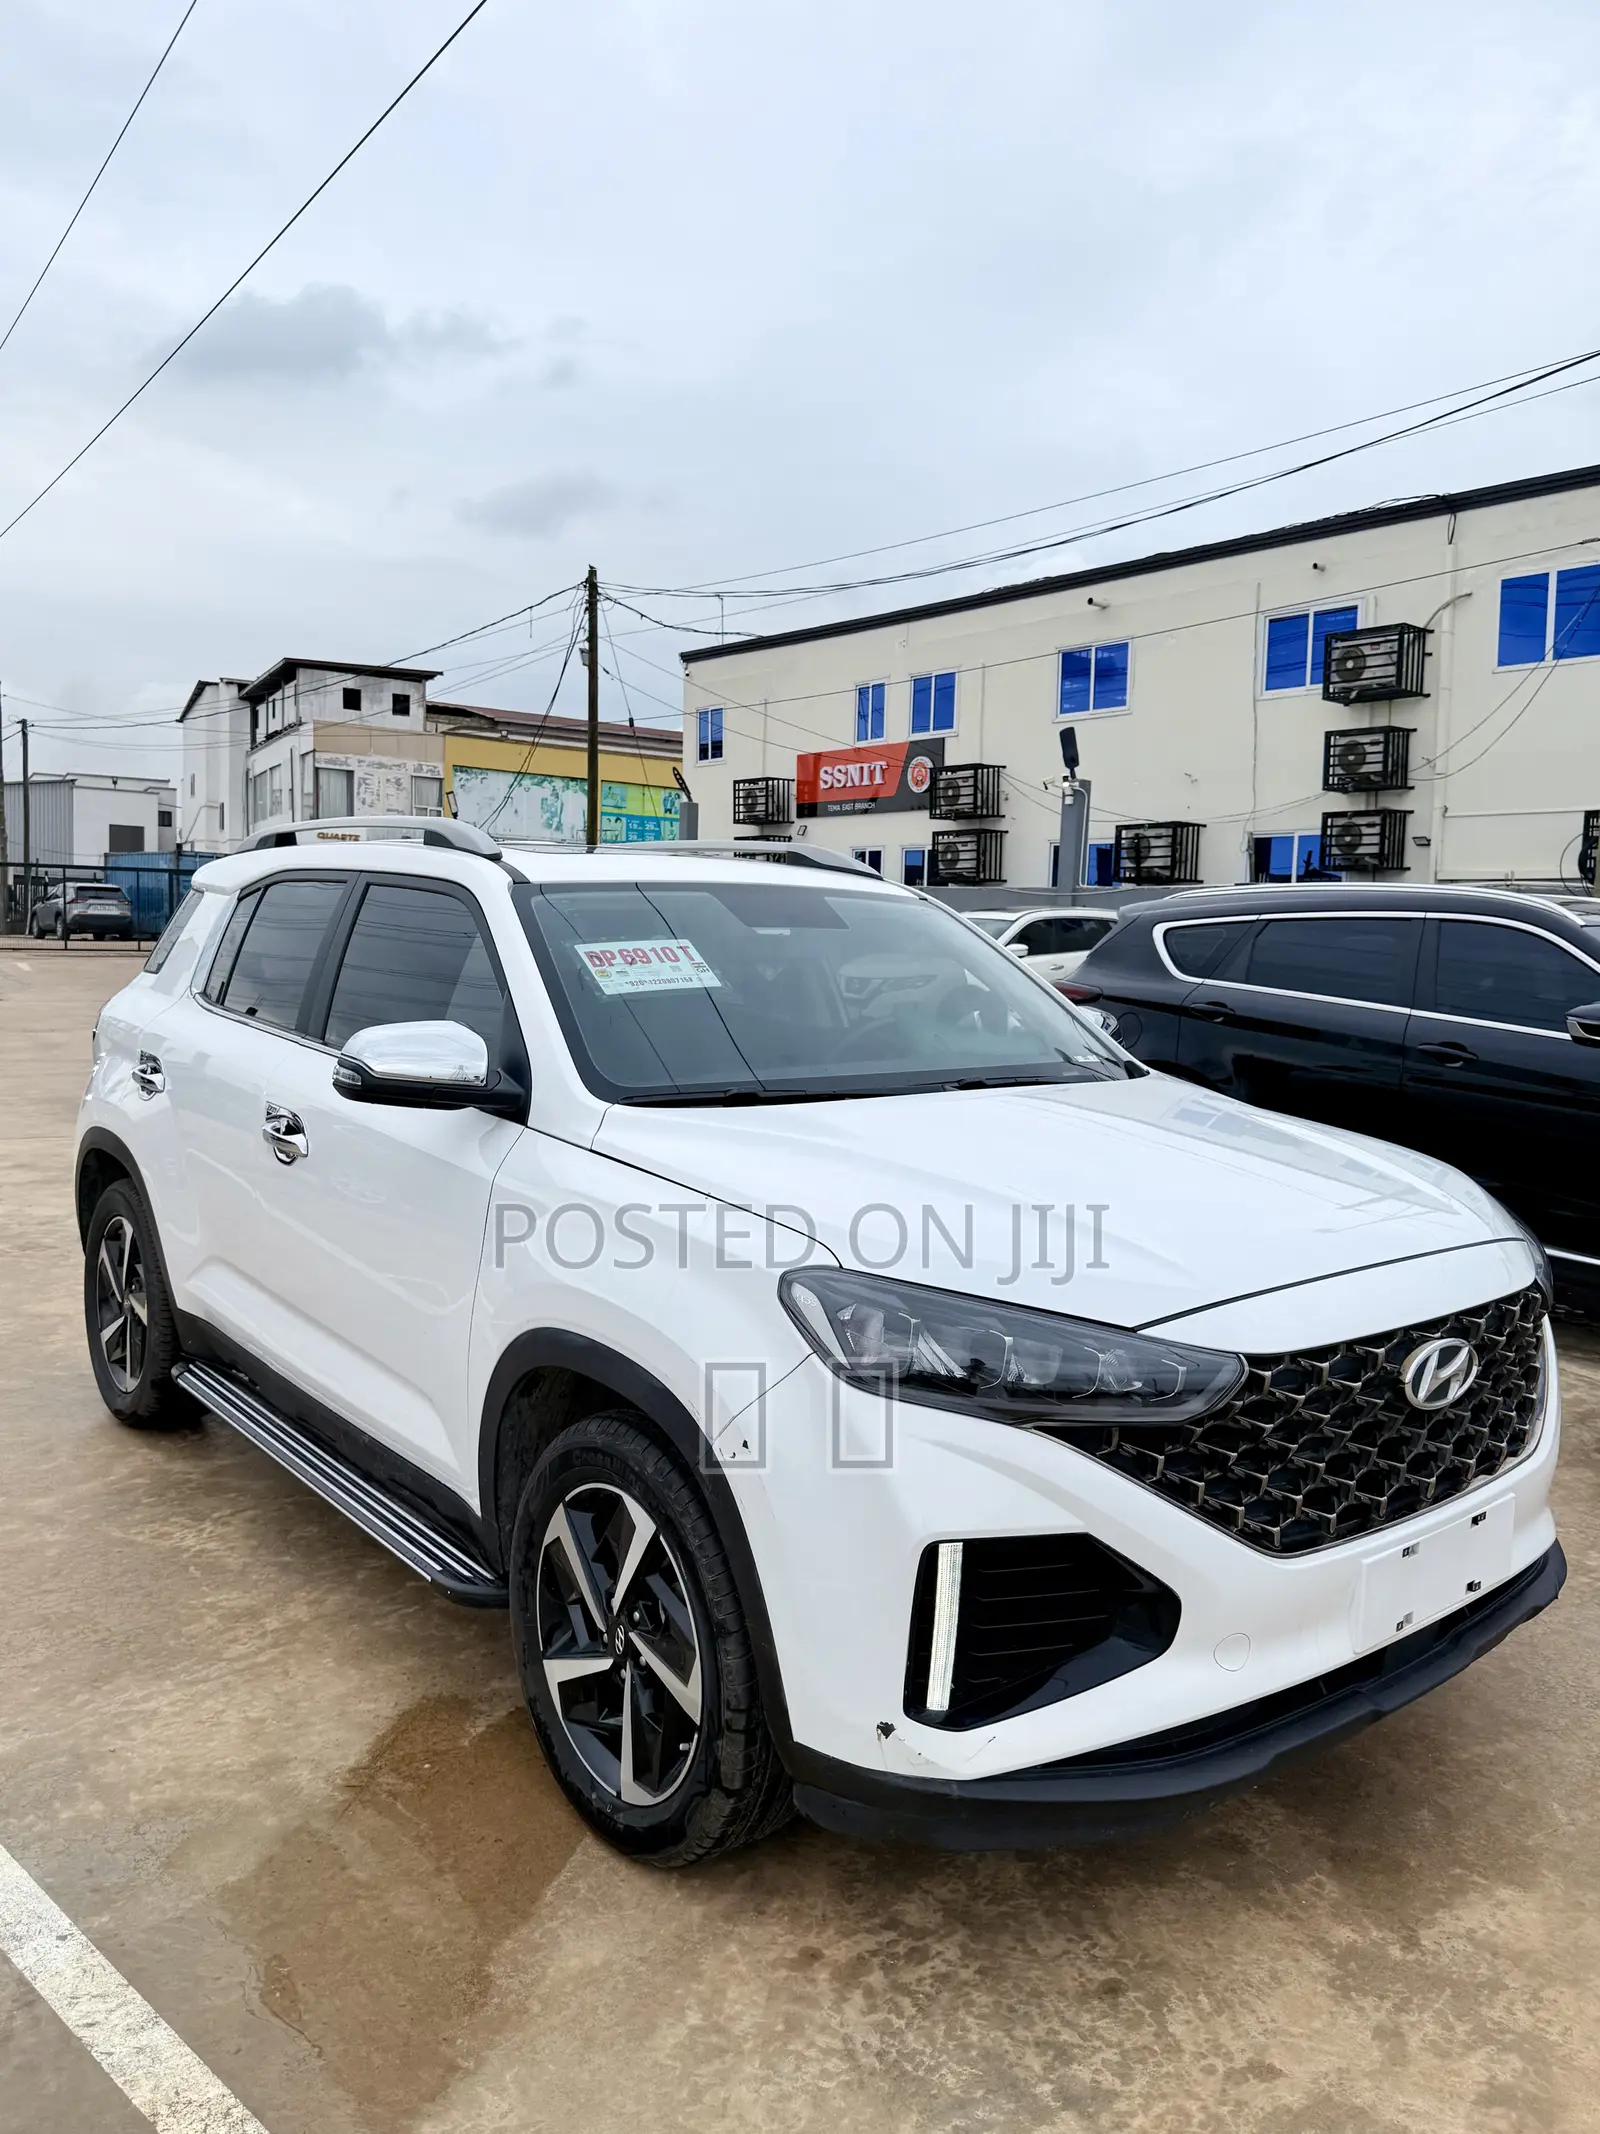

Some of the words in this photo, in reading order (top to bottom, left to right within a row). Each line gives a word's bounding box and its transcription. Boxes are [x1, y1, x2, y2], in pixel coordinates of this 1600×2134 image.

[819, 761, 889, 790] SSNIT
[841, 803, 854, 811] EAST
[854, 802, 876, 810] BRANCH
[583, 949, 617, 968] DP
[617, 946, 680, 966] 6910
[676, 945, 695, 962] T
